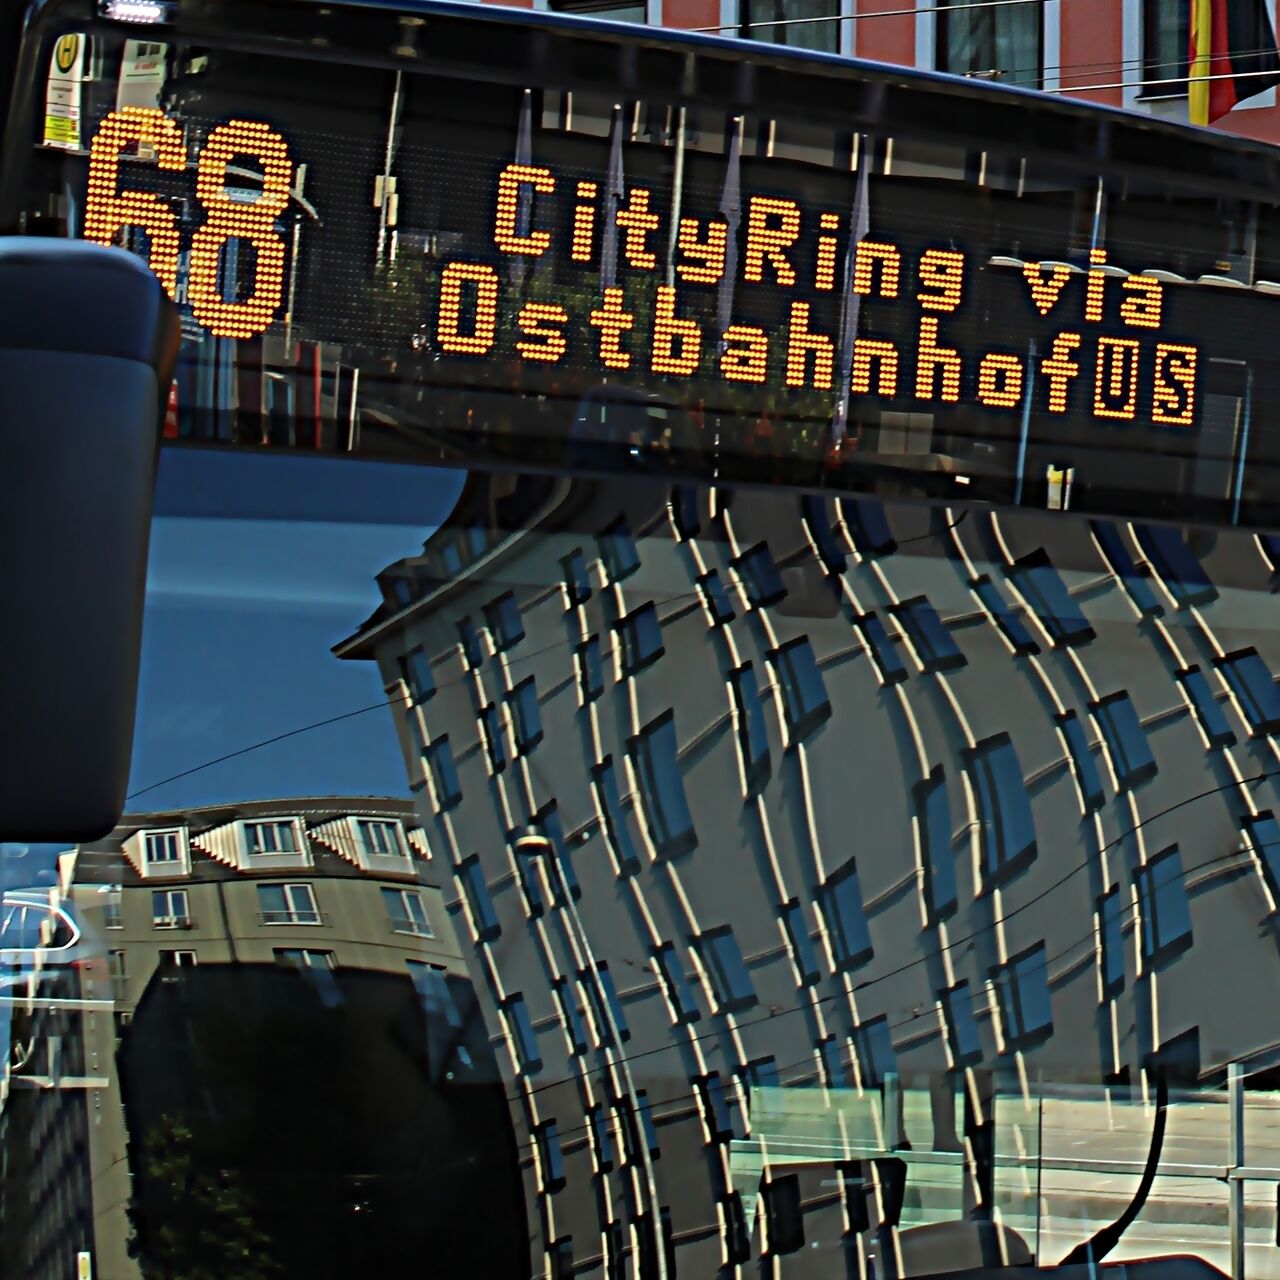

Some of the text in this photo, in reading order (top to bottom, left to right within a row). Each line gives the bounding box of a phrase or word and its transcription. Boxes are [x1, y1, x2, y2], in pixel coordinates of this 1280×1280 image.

[85, 105, 292, 339] 68
[495, 163, 1164, 329] CityRing via
